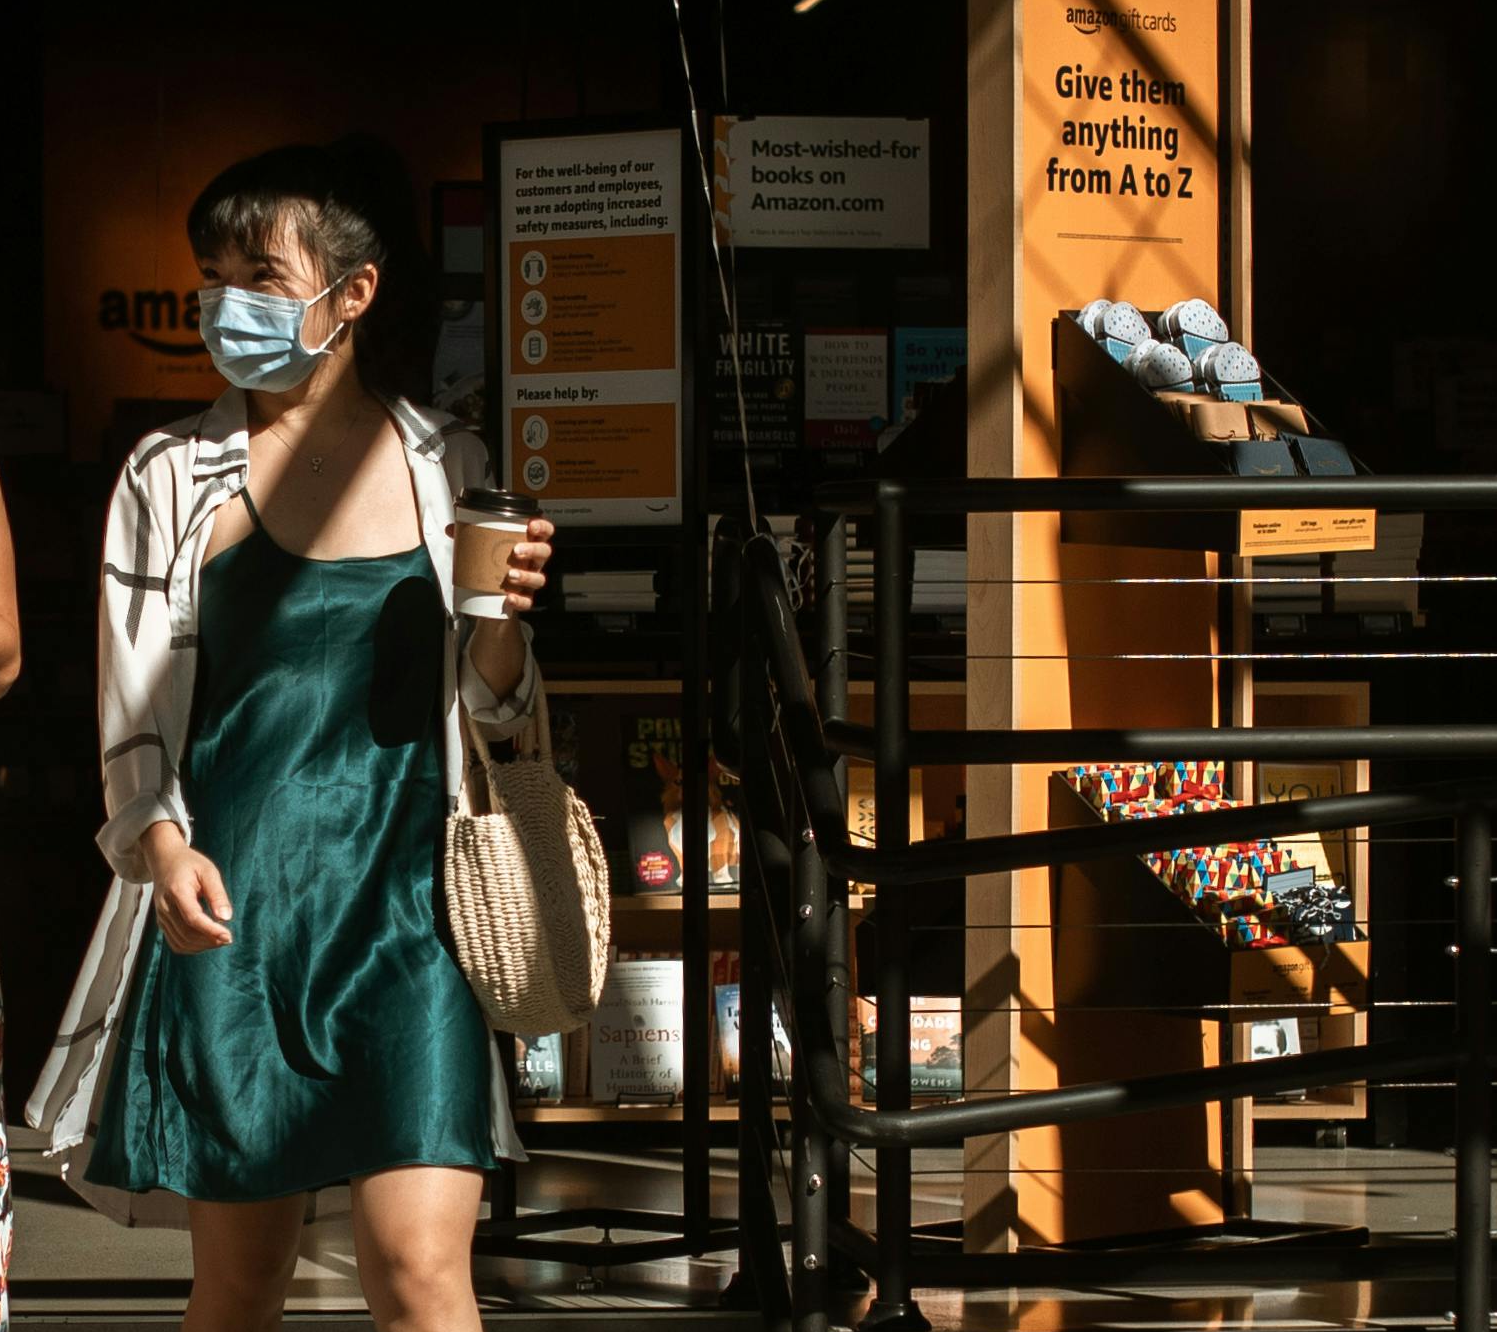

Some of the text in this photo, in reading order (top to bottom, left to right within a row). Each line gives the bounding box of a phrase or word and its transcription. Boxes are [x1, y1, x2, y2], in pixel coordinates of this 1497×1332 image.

[1066, 7, 1177, 33] amazon gift cards
[1055, 64, 1186, 107] Give them
[1062, 115, 1179, 160] anything
[752, 140, 921, 159] Most-wished-for
[516, 160, 654, 179] For the well-being of our
[752, 166, 845, 184] books on
[1047, 158, 1193, 199] from A to Z
[516, 179, 663, 197] customers and employees,
[516, 195, 661, 215] we are adopting increased
[751, 193, 884, 211] Amazon.com
[516, 214, 668, 236] safety measures, including:
[97, 289, 200, 331] ama
[718, 333, 791, 356] WHITE
[906, 345, 926, 357] So
[716, 358, 796, 376] FRGILITY
[517, 386, 599, 401] Please help by:
[826, 383, 868, 393] PEOPLE
[599, 1026, 681, 1048] Sapiens
[620, 1054, 661, 1065] A Brief
[610, 1067, 672, 1083] History of
[911, 1077, 952, 1088] OWENS
[606, 1081, 678, 1094] Humankind
